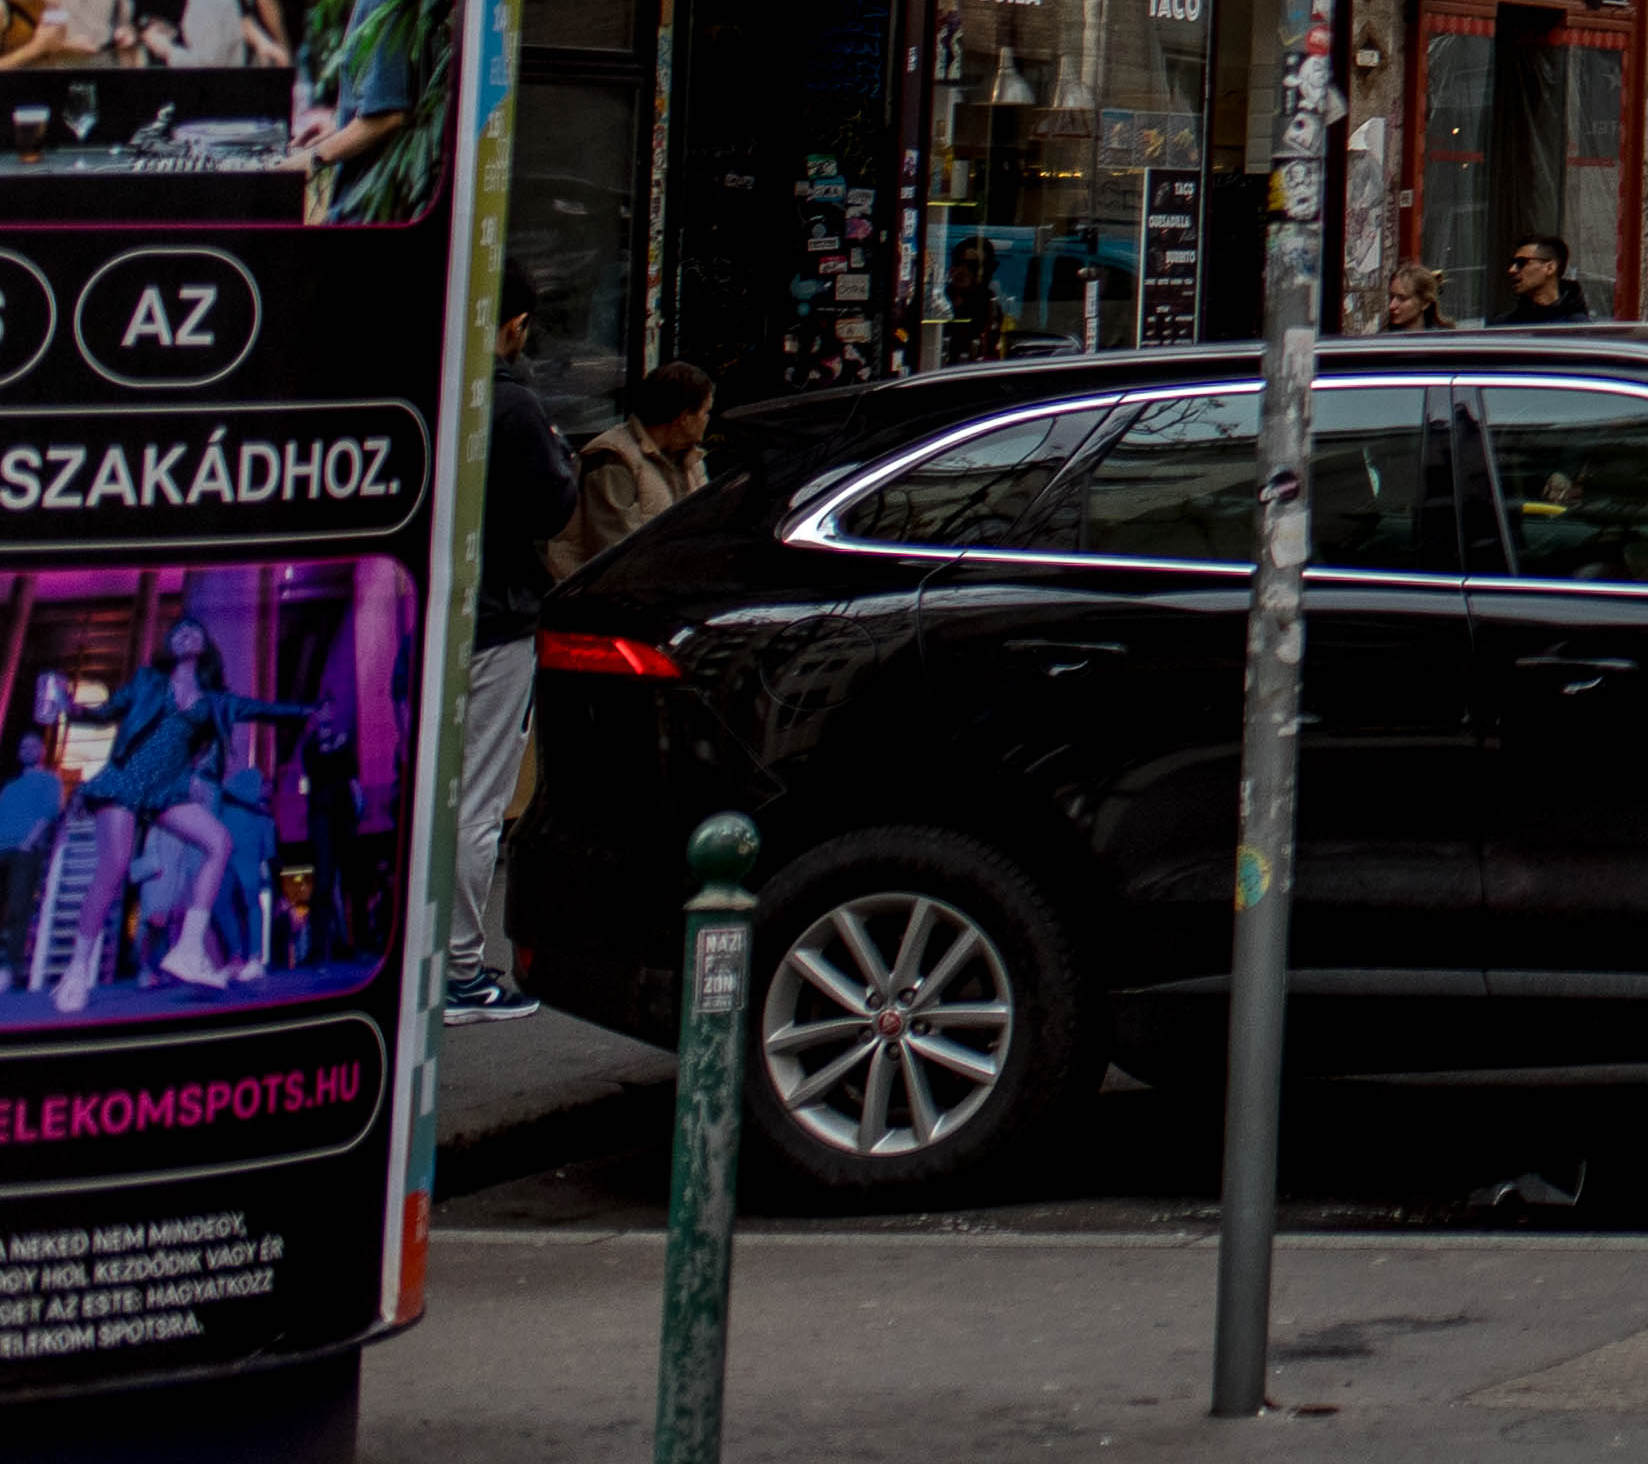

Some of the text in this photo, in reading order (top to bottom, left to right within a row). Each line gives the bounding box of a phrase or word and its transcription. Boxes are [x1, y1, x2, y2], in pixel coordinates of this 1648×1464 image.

[121, 284, 218, 348] AZ
[0, 1059, 361, 1145] ELEKOMSPOTS.HU
[92, 1223, 145, 1253] NEM
